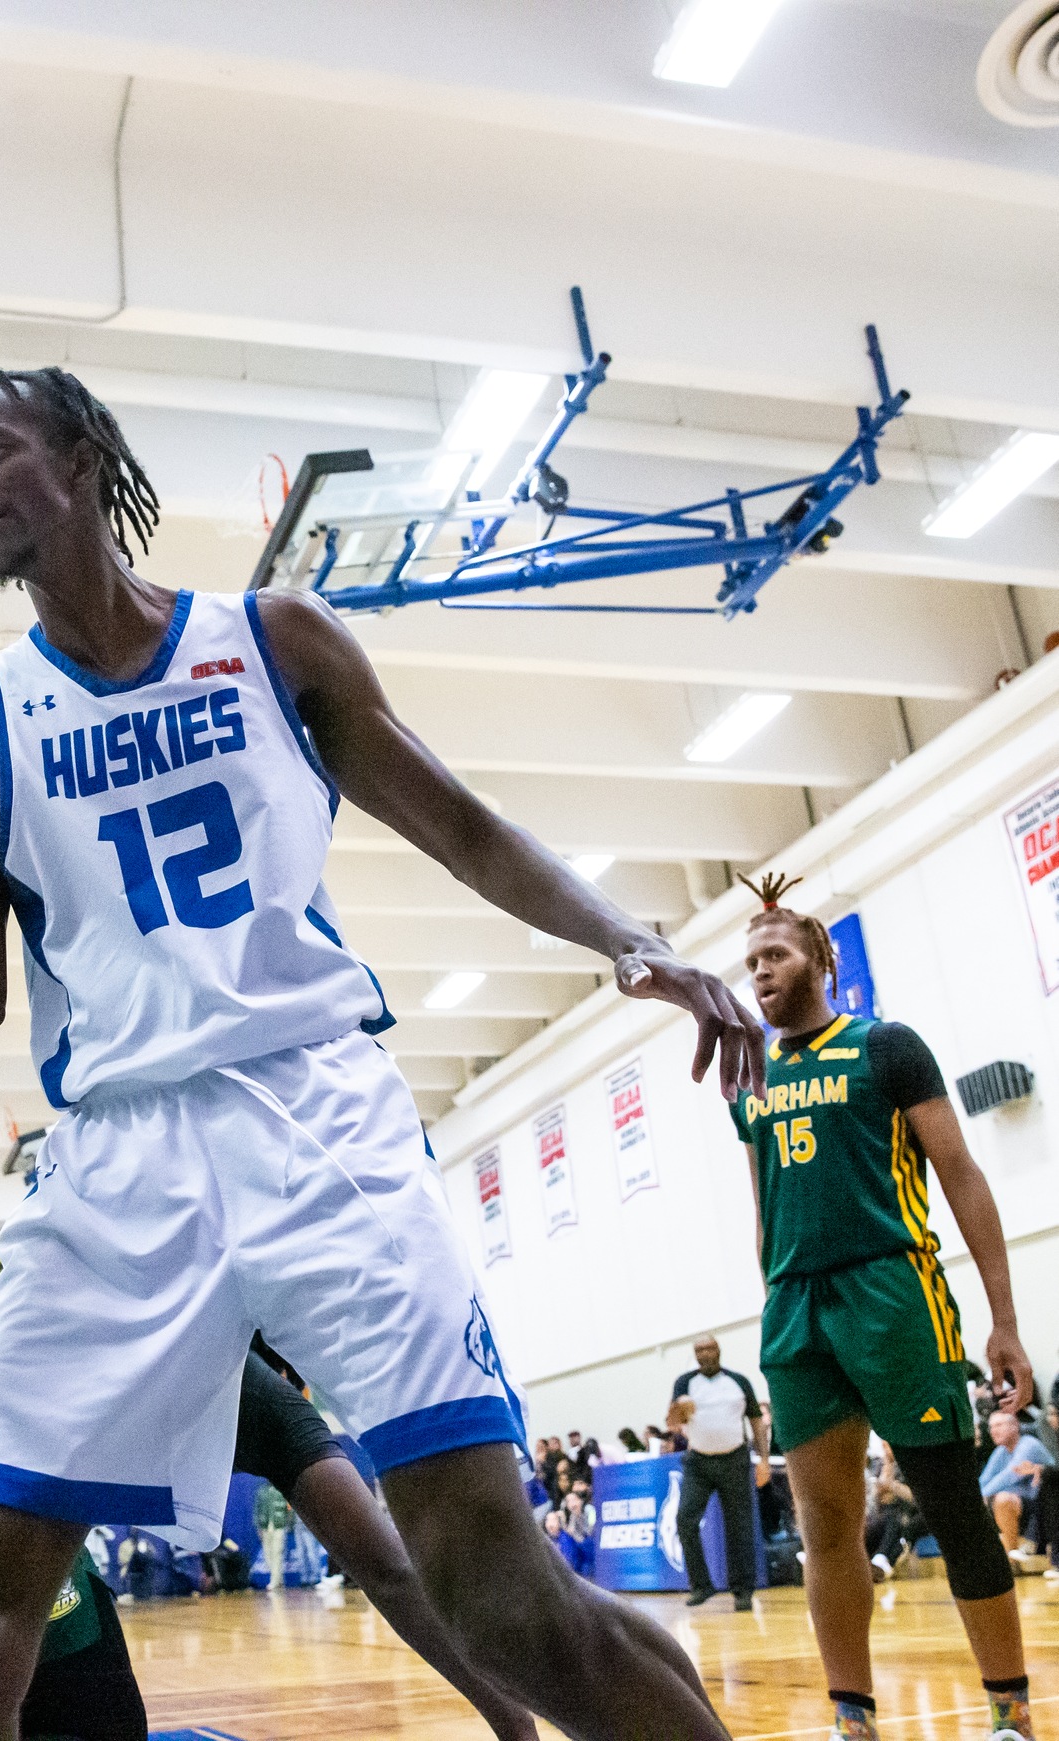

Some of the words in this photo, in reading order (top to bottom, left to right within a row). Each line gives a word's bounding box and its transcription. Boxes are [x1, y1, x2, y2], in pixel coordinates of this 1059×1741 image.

[191, 657, 246, 680] OCAA
[41, 687, 247, 800] HUSKIES
[97, 780, 255, 937] 12
[745, 1075, 848, 1125] DURHAM
[773, 1116, 818, 1169] 15
